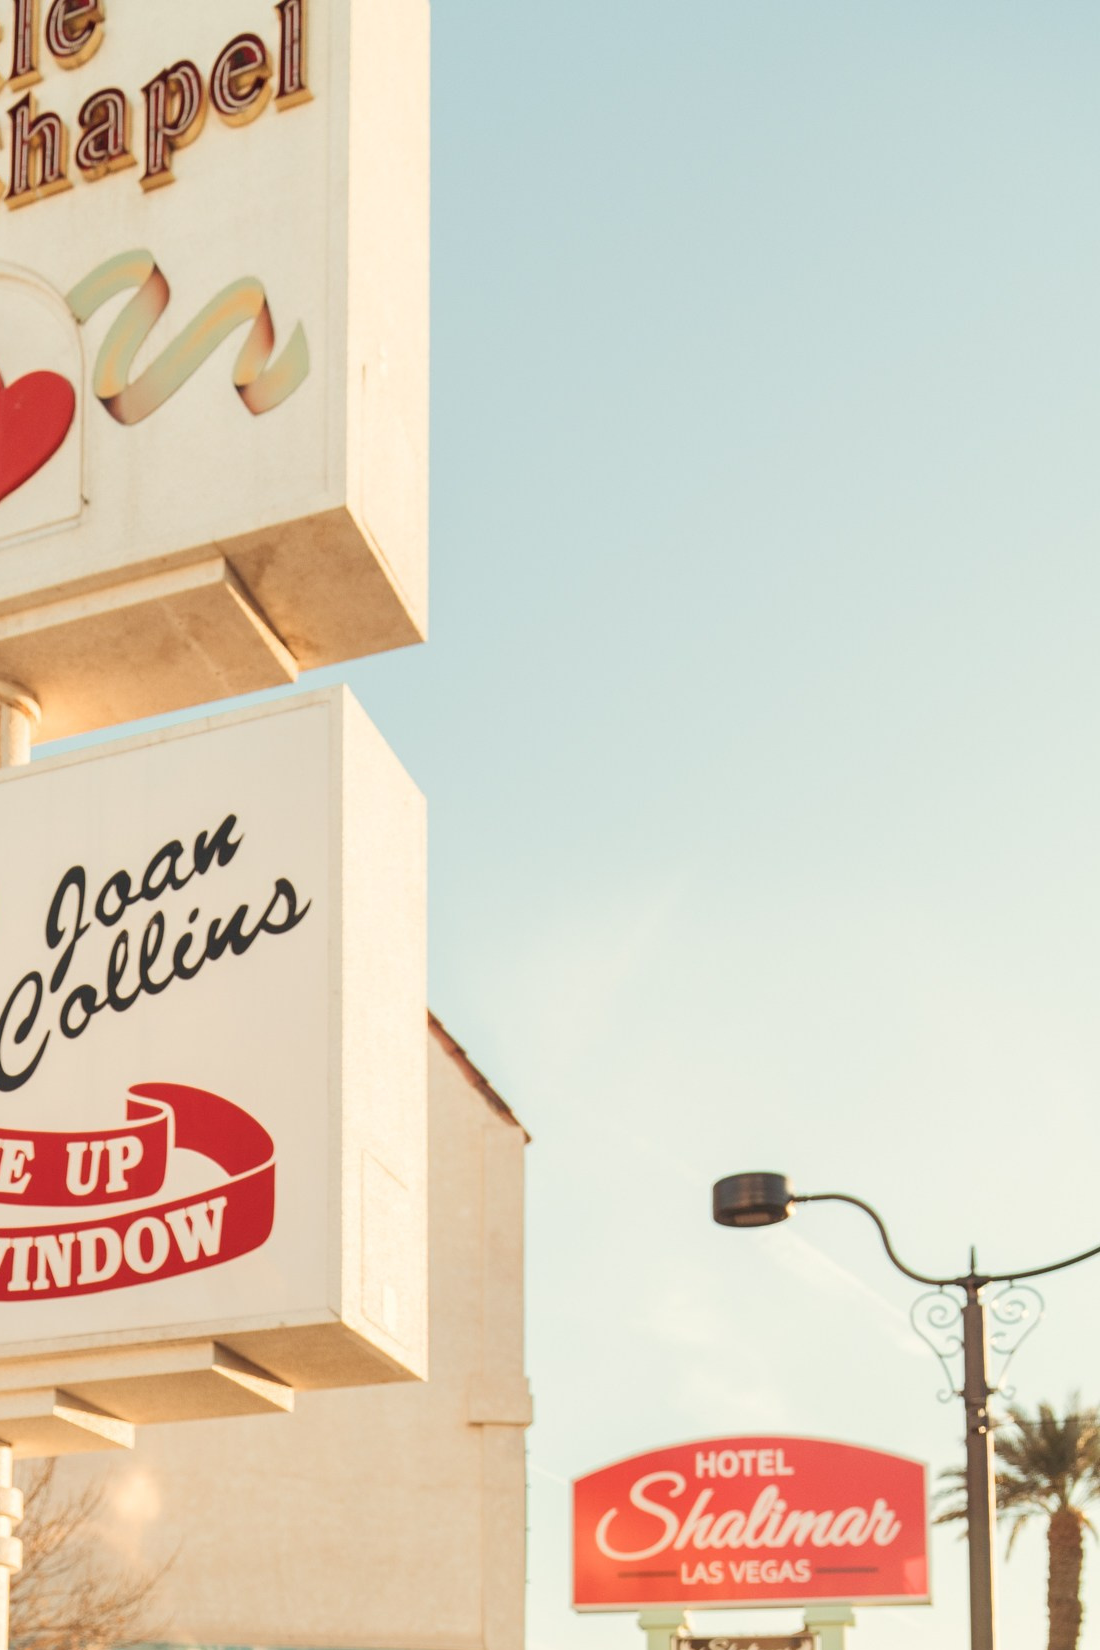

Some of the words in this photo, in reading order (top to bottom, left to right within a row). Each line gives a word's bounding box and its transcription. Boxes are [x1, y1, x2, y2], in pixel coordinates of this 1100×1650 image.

[46, 814, 243, 993] Joan
[66, 1135, 144, 1196] UP
[695, 1449, 795, 1478] HOTEL
[596, 1471, 901, 1561] Shalimar
[681, 1561, 724, 1584] LAS
[729, 1559, 811, 1583] VEGAS
